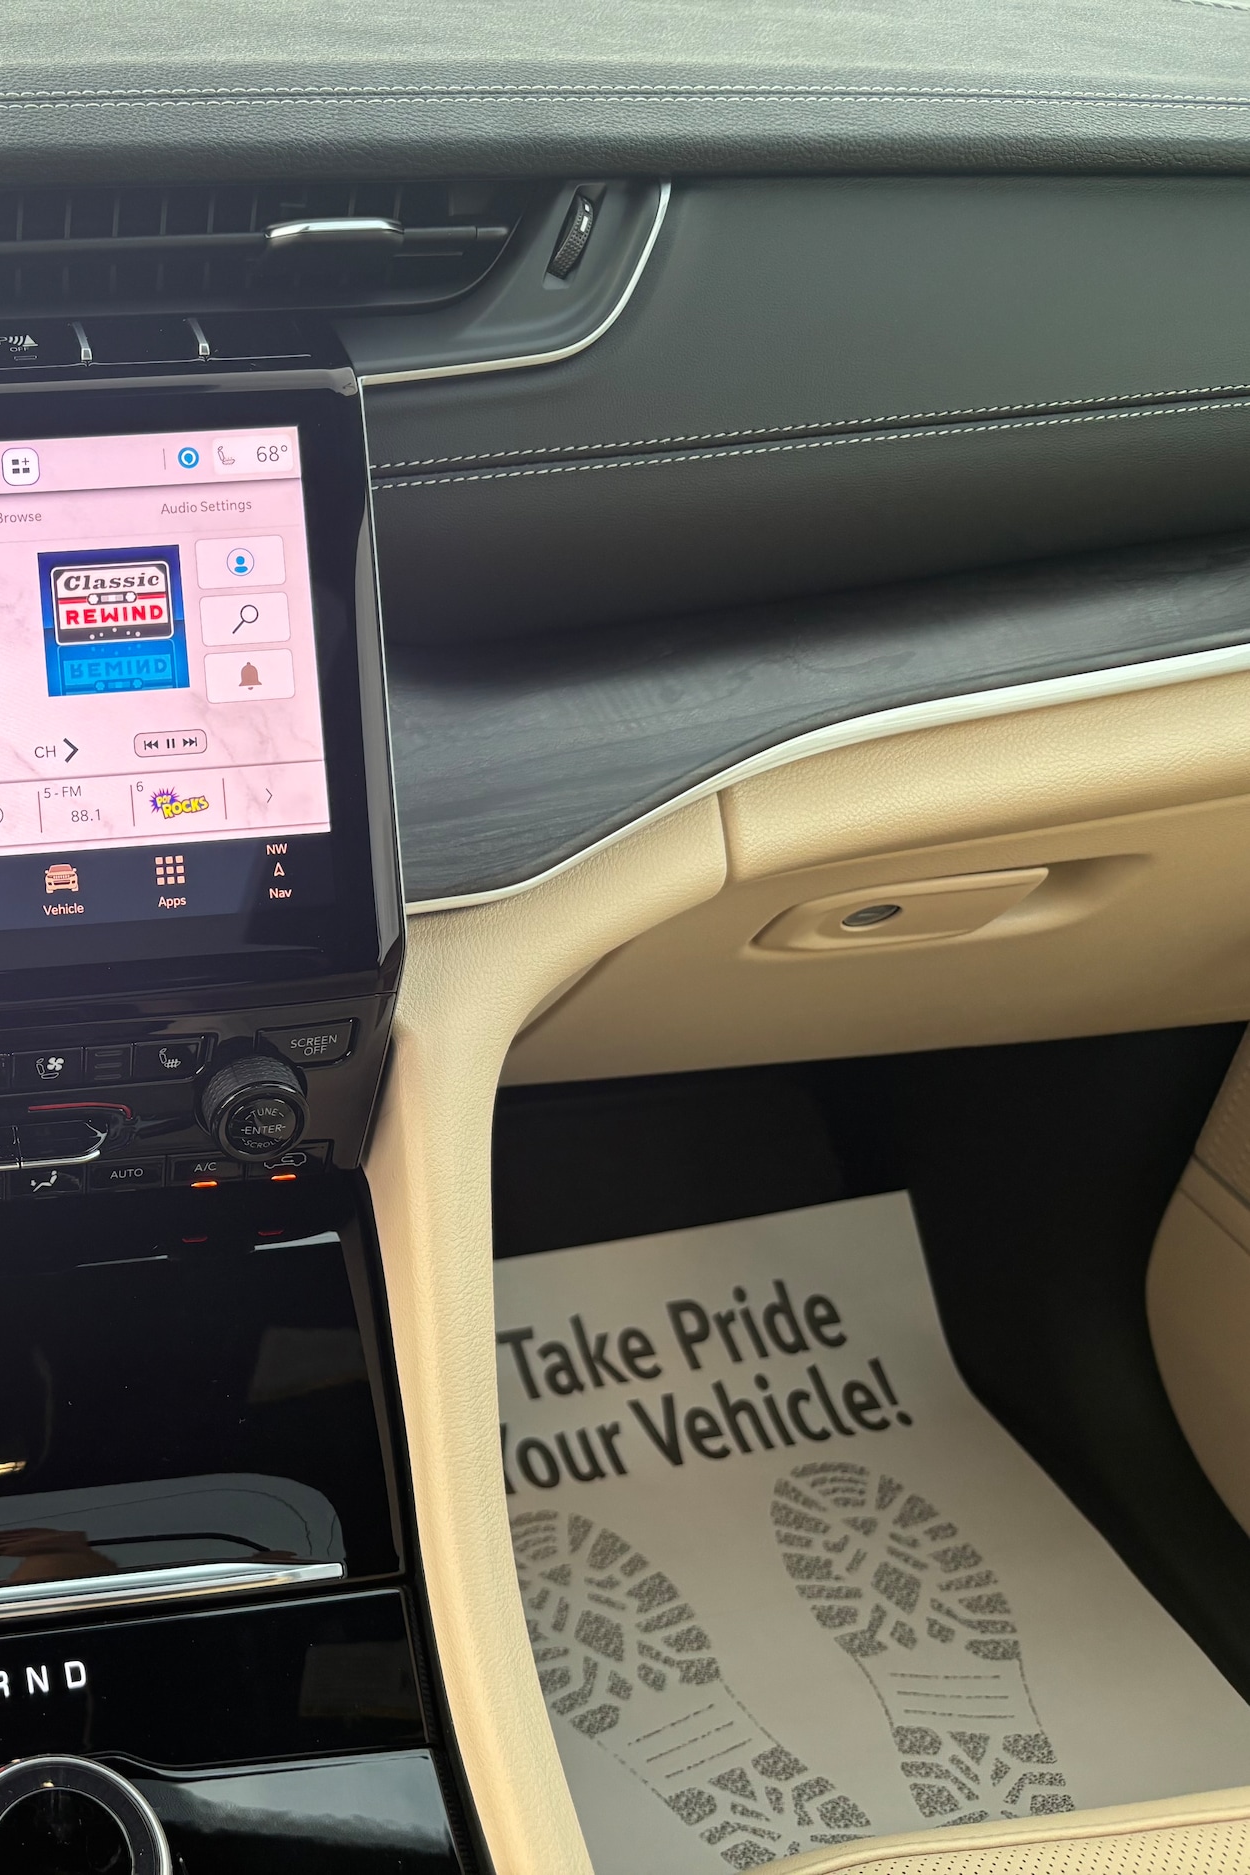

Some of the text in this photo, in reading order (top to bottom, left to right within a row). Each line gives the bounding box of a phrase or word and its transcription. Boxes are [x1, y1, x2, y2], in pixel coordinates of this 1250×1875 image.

[256, 444, 288, 463] 68°
[160, 498, 252, 516] Audio Settings
[63, 572, 160, 591] Classic
[65, 604, 163, 626] REWIND
[34, 745, 56, 759] CH
[44, 787, 51, 798] 5
[62, 786, 81, 797] FM
[136, 781, 144, 792] 6
[162, 796, 209, 819] ROCKS
[71, 808, 101, 823] 88.1
[266, 844, 287, 855] NW
[269, 887, 292, 899] Nav
[158, 895, 186, 909] Apps
[43, 903, 84, 916] Vehicle
[290, 1034, 338, 1050] SCREEN
[303, 1044, 327, 1056] OFF
[110, 1167, 143, 1179] AUTO
[194, 1161, 216, 1173] A/C
[495, 1279, 848, 1400] Take Pride
[627, 1357, 913, 1467] Vehicle!
[26, 1665, 50, 1694] N
[64, 1660, 87, 1688] D
